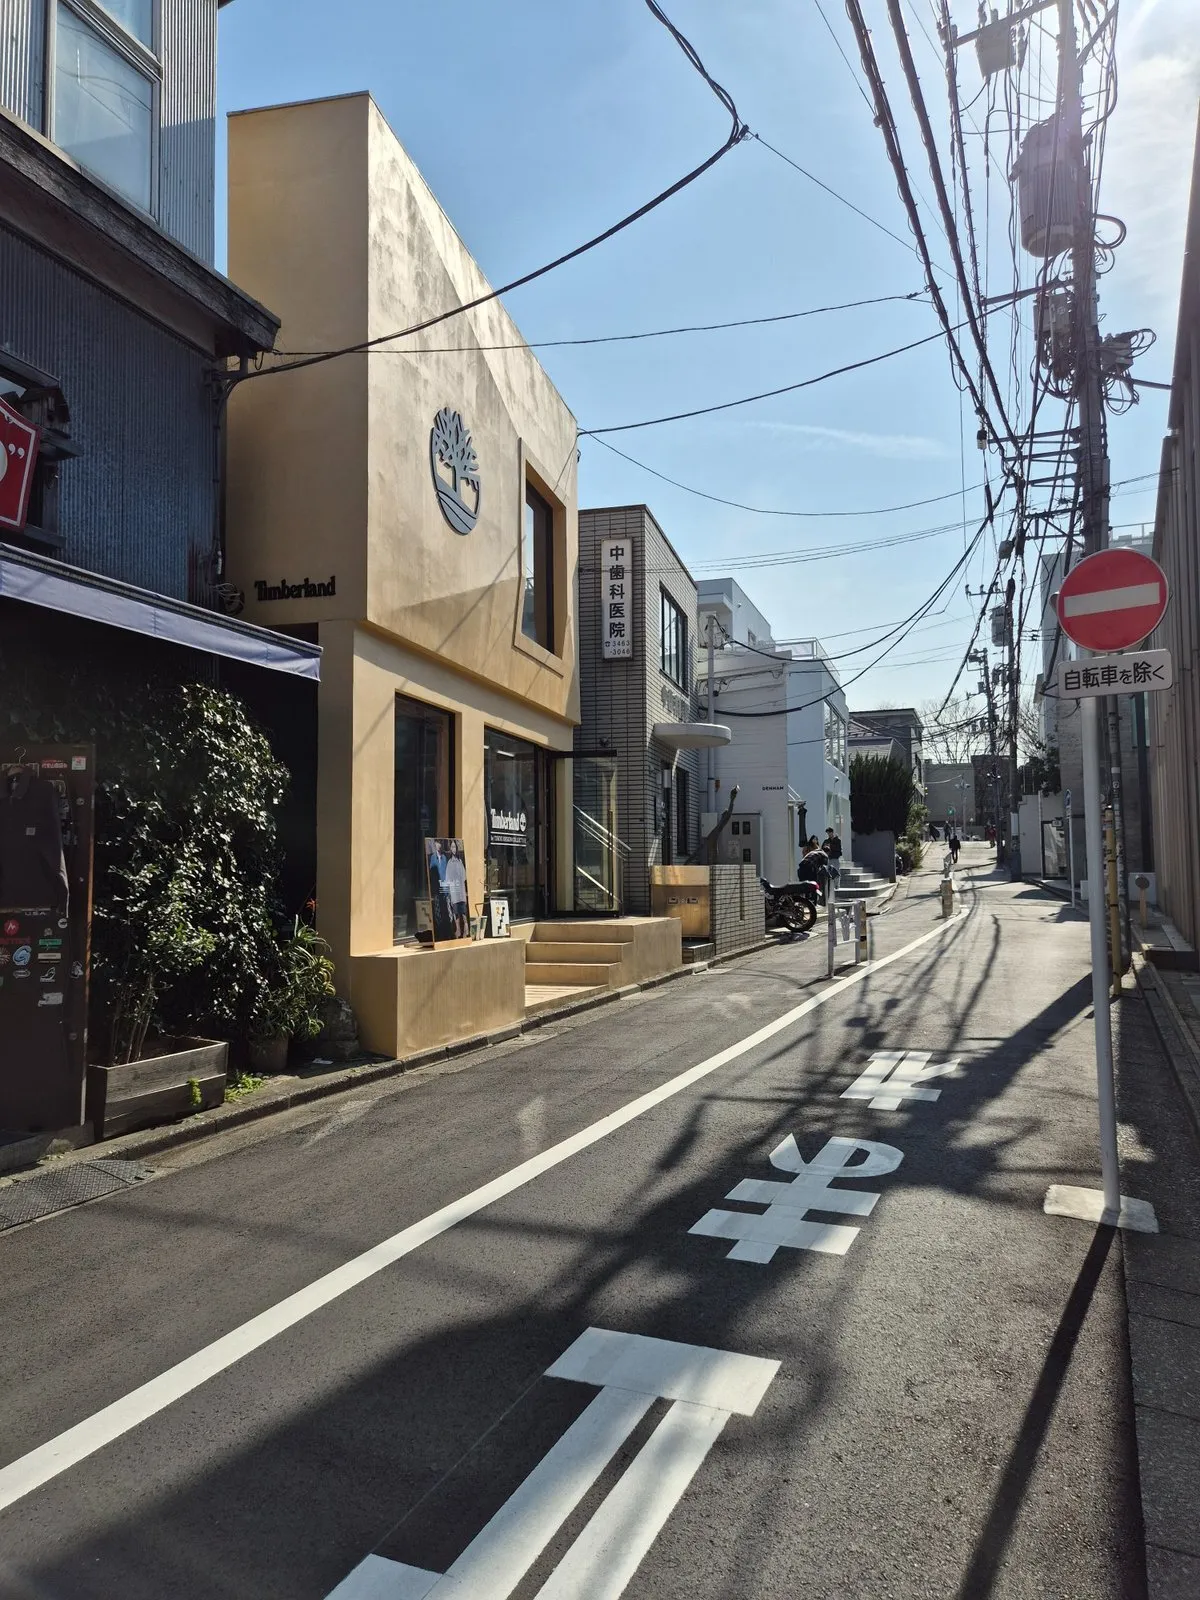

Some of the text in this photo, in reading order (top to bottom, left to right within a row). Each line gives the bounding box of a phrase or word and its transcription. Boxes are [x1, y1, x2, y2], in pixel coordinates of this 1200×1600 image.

[254, 575, 336, 601] Timberland
[609, 545, 626, 639] 中歯科医院
[1064, 661, 1165, 690] 自転車を除く
[490, 808, 519, 831] Timberland
